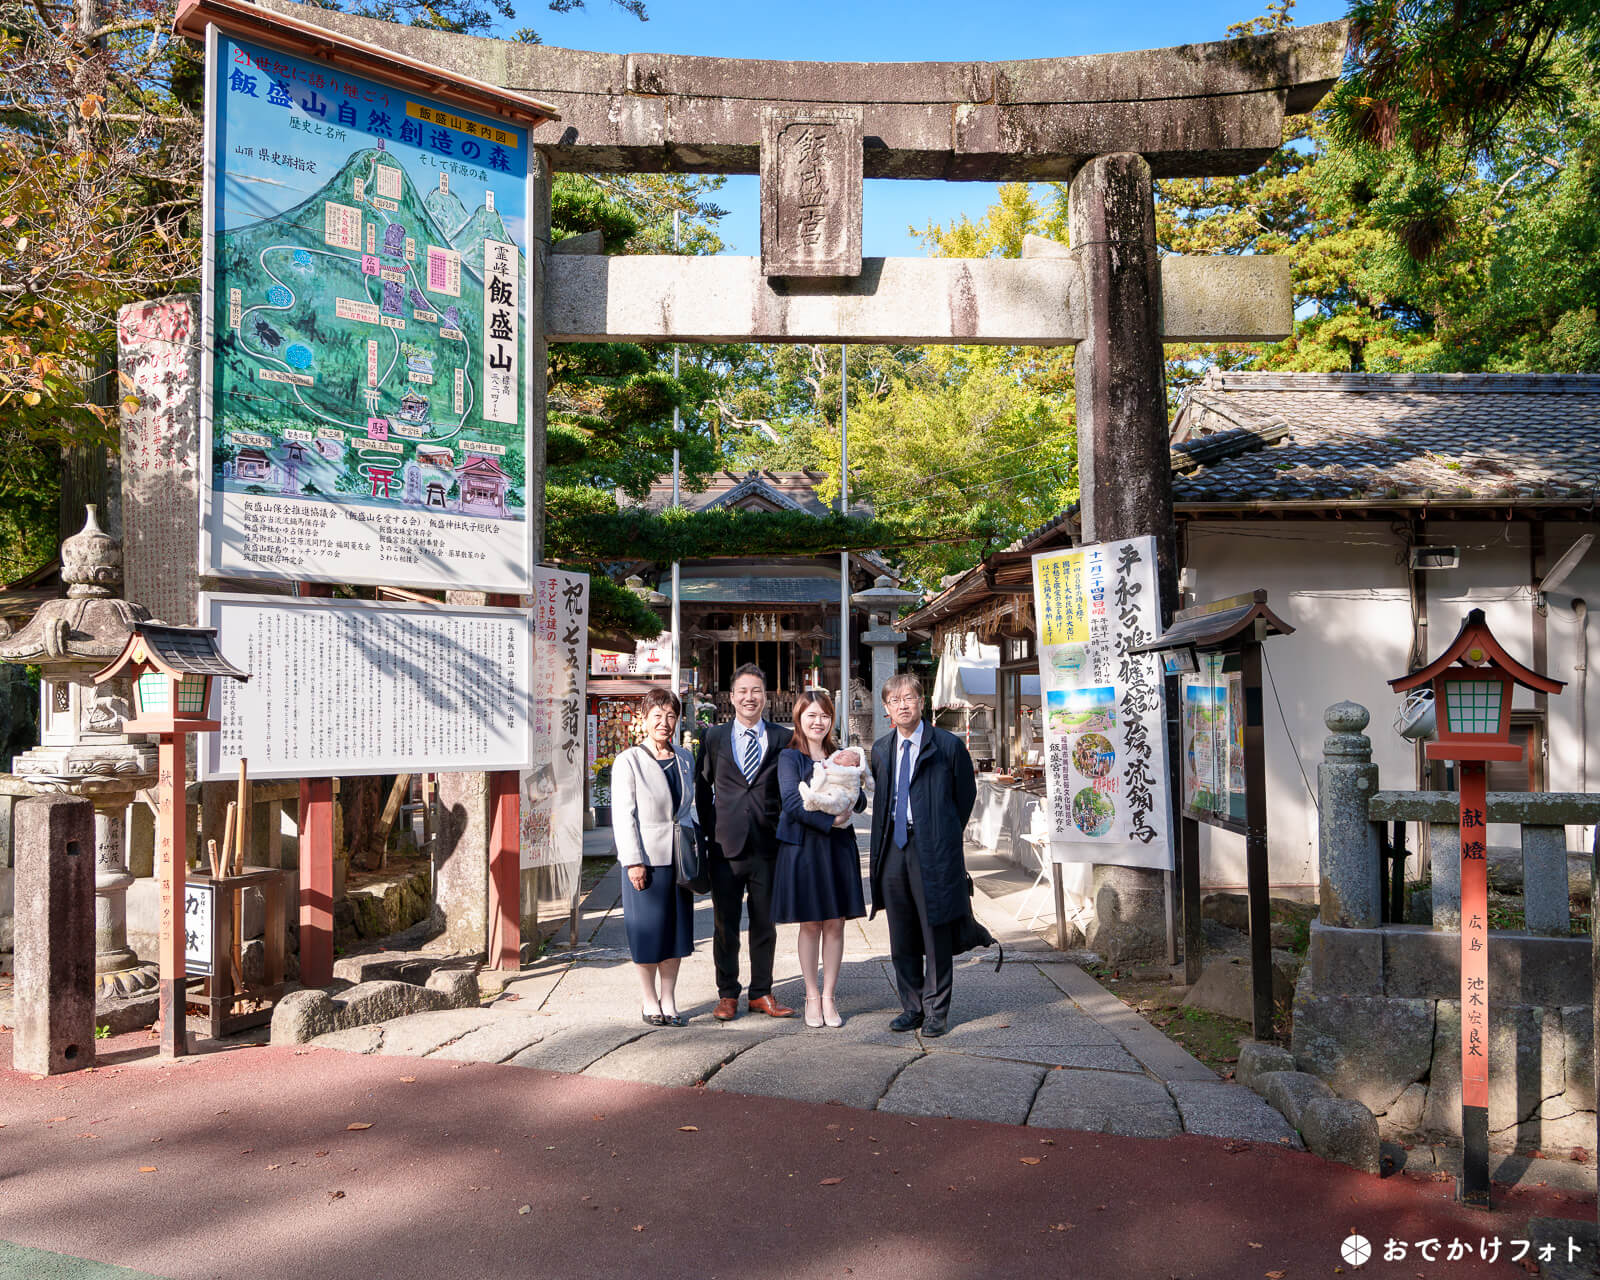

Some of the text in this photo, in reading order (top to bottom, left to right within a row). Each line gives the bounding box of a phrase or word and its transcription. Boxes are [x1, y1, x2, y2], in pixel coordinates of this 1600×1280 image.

[234, 48, 391, 108] 21世紀に語り継ごう
[229, 67, 513, 171] 飯盛山自然創造の森
[289, 116, 346, 142] 歴史と名所
[420, 107, 506, 144] 飯盛山案内図
[235, 145, 317, 174] 山頂 県史跡指定
[365, 257, 376, 274] 広場
[488, 275, 515, 373] 飯盛山
[502, 374, 511, 396] 標高
[372, 422, 385, 435] 駐
[1462, 807, 1485, 860] 献燈
